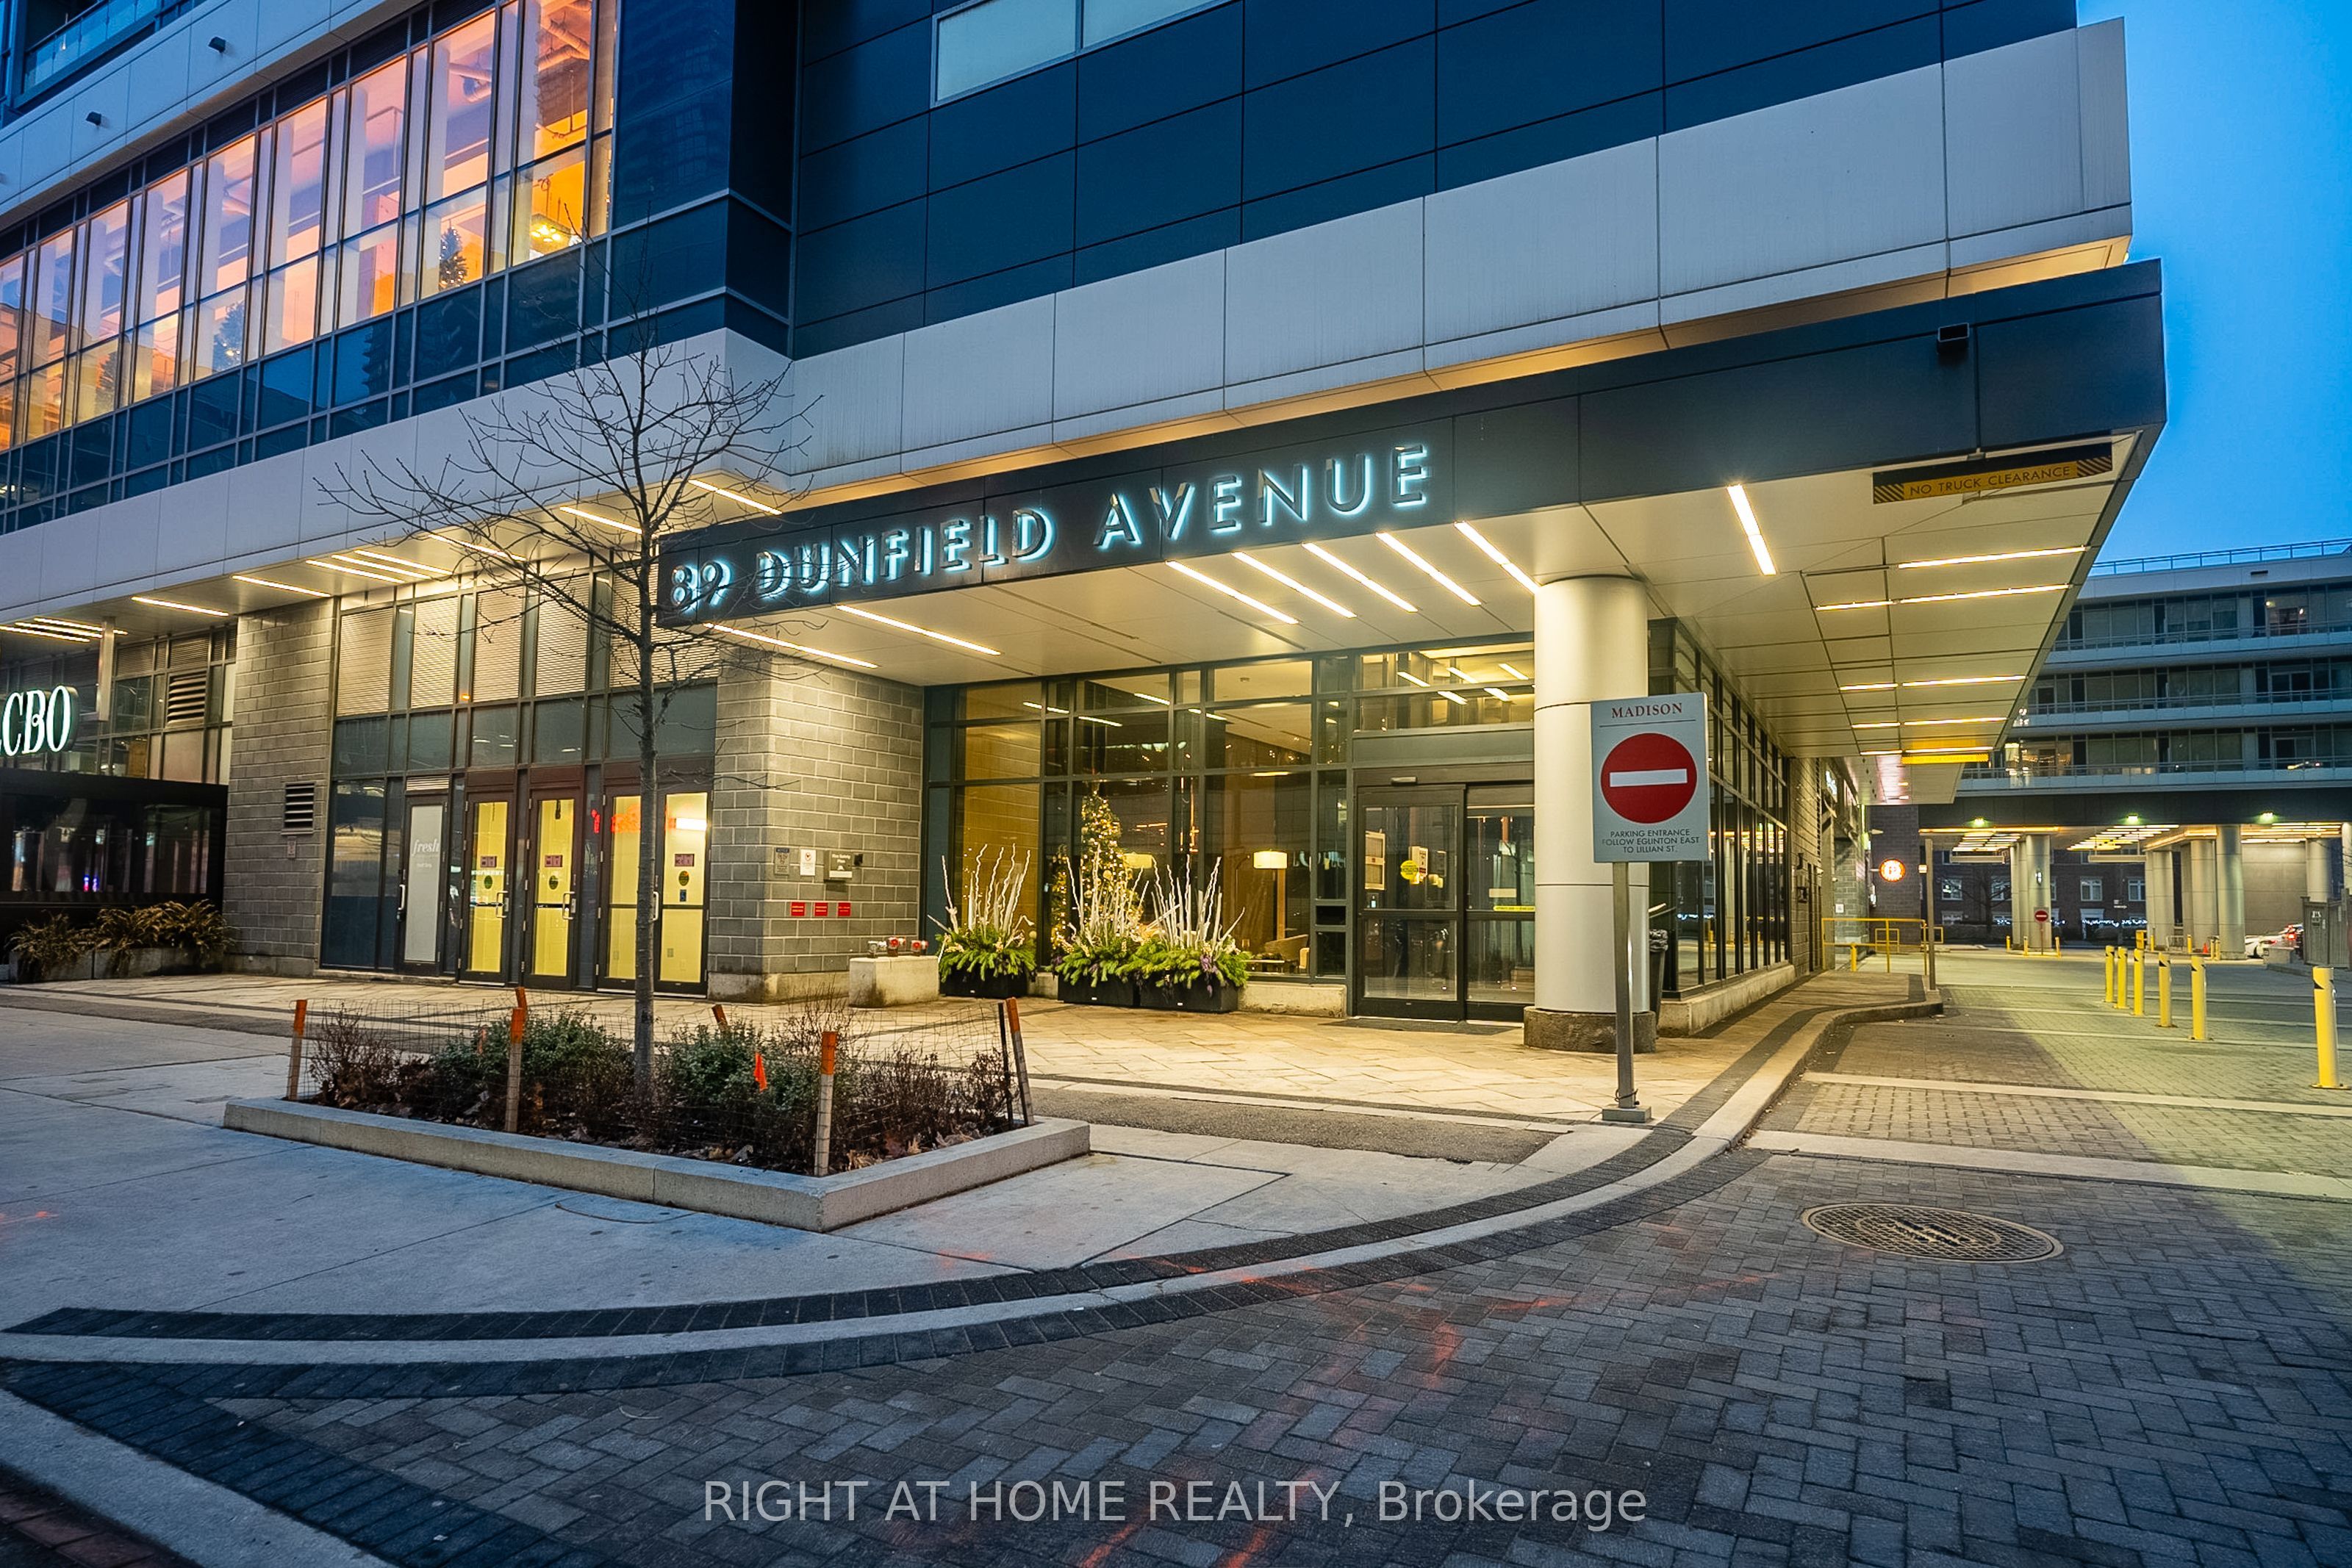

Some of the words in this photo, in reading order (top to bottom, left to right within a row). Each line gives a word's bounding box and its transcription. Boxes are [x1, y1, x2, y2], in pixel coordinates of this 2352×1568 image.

[1910, 483, 1932, 495] NO
[1938, 478, 1982, 492] TRUCK
[1988, 466, 2070, 486] CLEARANCE
[669, 558, 731, 614] 89
[755, 507, 1056, 601] DUNFIELD
[1093, 444, 1429, 550] AVENUE
[1612, 702, 1682, 719] MADISON
[0, 686, 71, 757] CBO
[1610, 830, 1646, 838] PARKING
[1647, 829, 1690, 837] ENTRANCE
[1680, 836, 1700, 844] EAST
[412, 838, 440, 856] fresh
